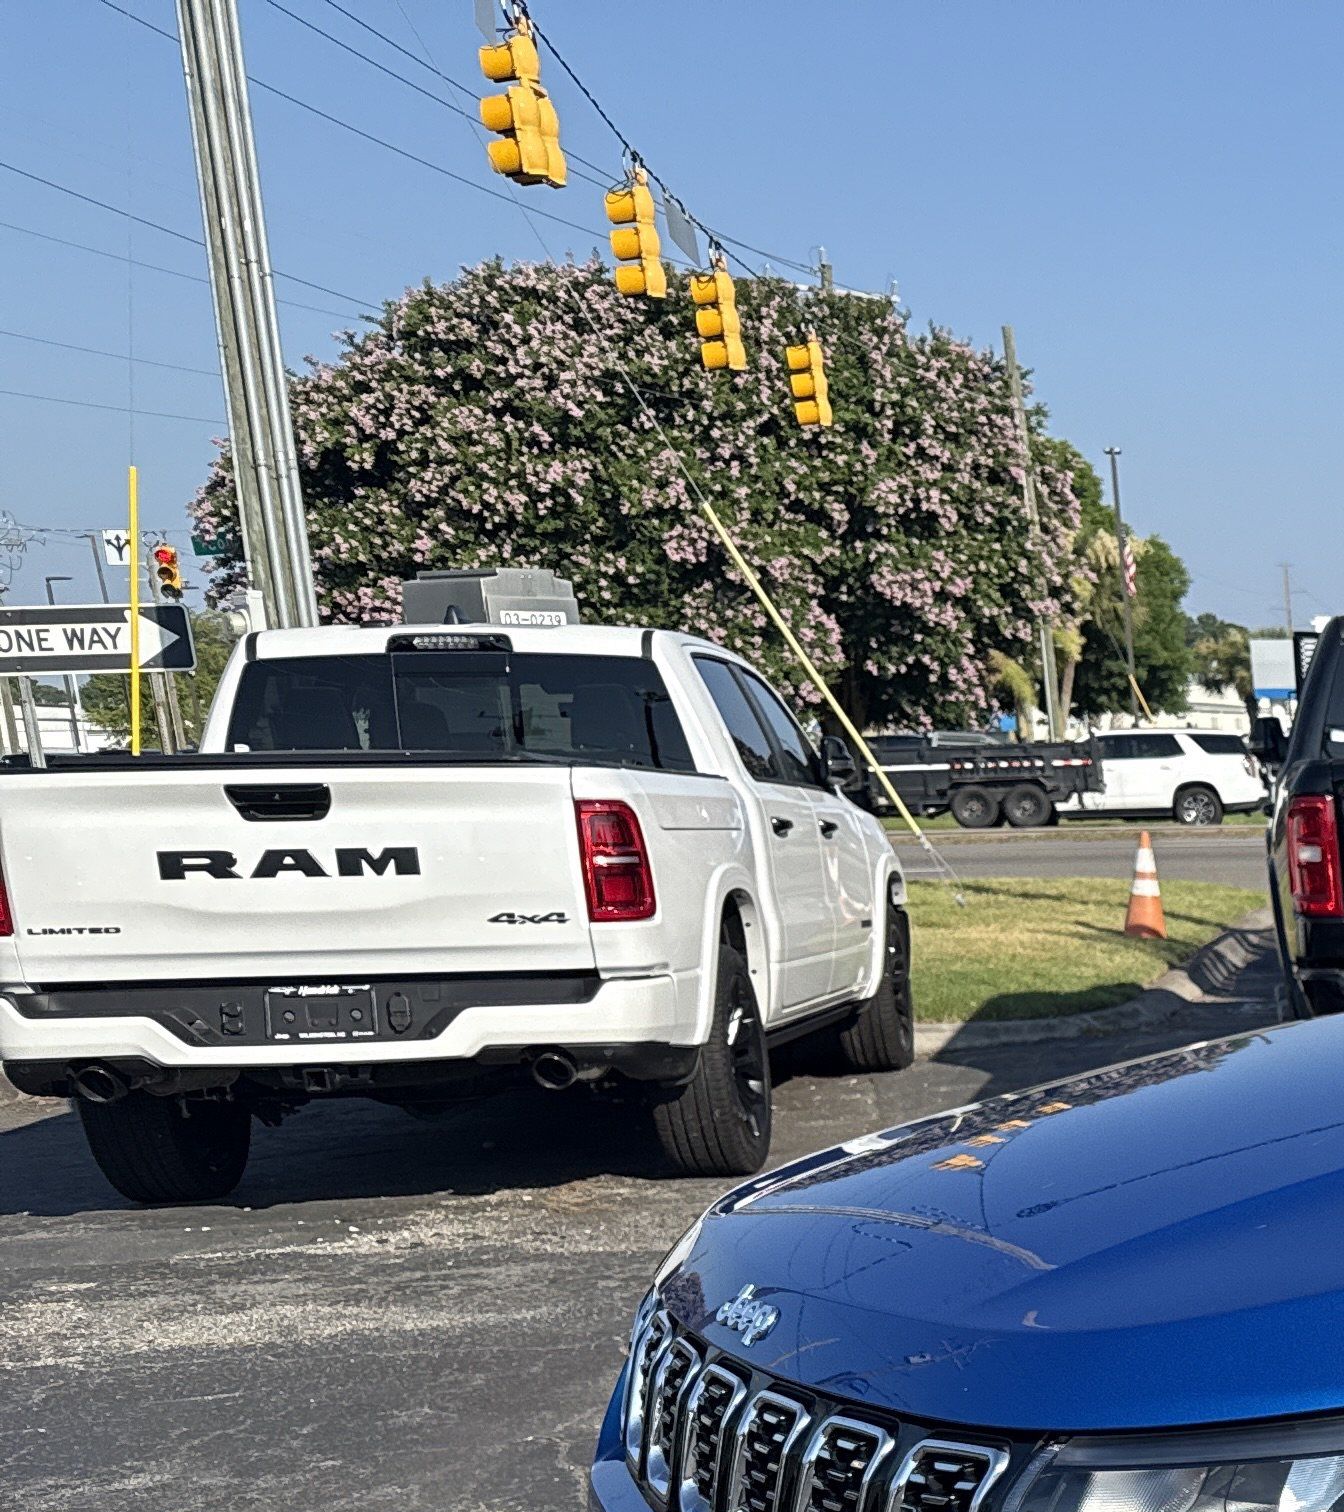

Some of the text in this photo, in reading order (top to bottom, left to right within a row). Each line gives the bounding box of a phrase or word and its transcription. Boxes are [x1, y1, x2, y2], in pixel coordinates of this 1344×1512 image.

[0, 626, 122, 654] ONE WAY
[156, 846, 421, 880] RAM
[26, 926, 121, 936] LIMITED
[486, 911, 571, 925] 4x4
[715, 1283, 780, 1347] Jeep
